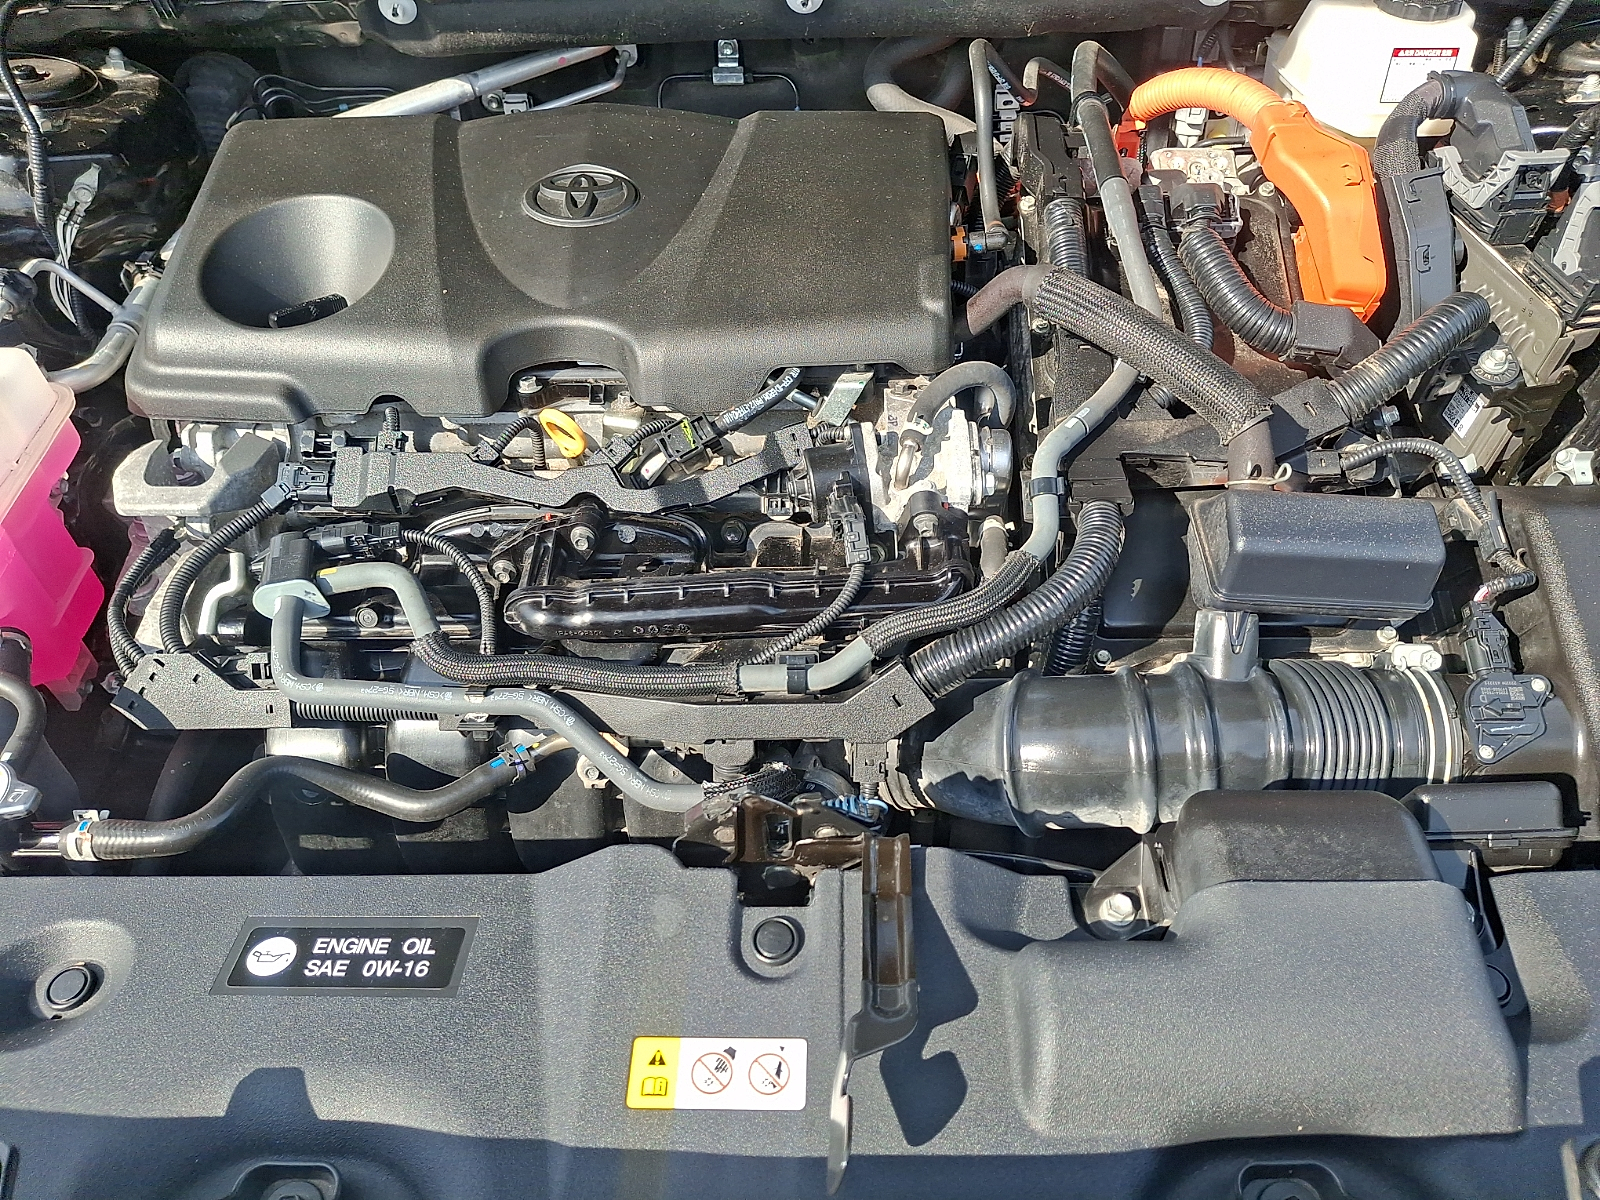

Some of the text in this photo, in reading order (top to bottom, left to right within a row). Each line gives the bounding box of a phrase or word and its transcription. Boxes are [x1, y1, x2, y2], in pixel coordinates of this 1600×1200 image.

[312, 937, 436, 955] ENGINE OIL
[303, 960, 430, 977] SAE 0W-16
